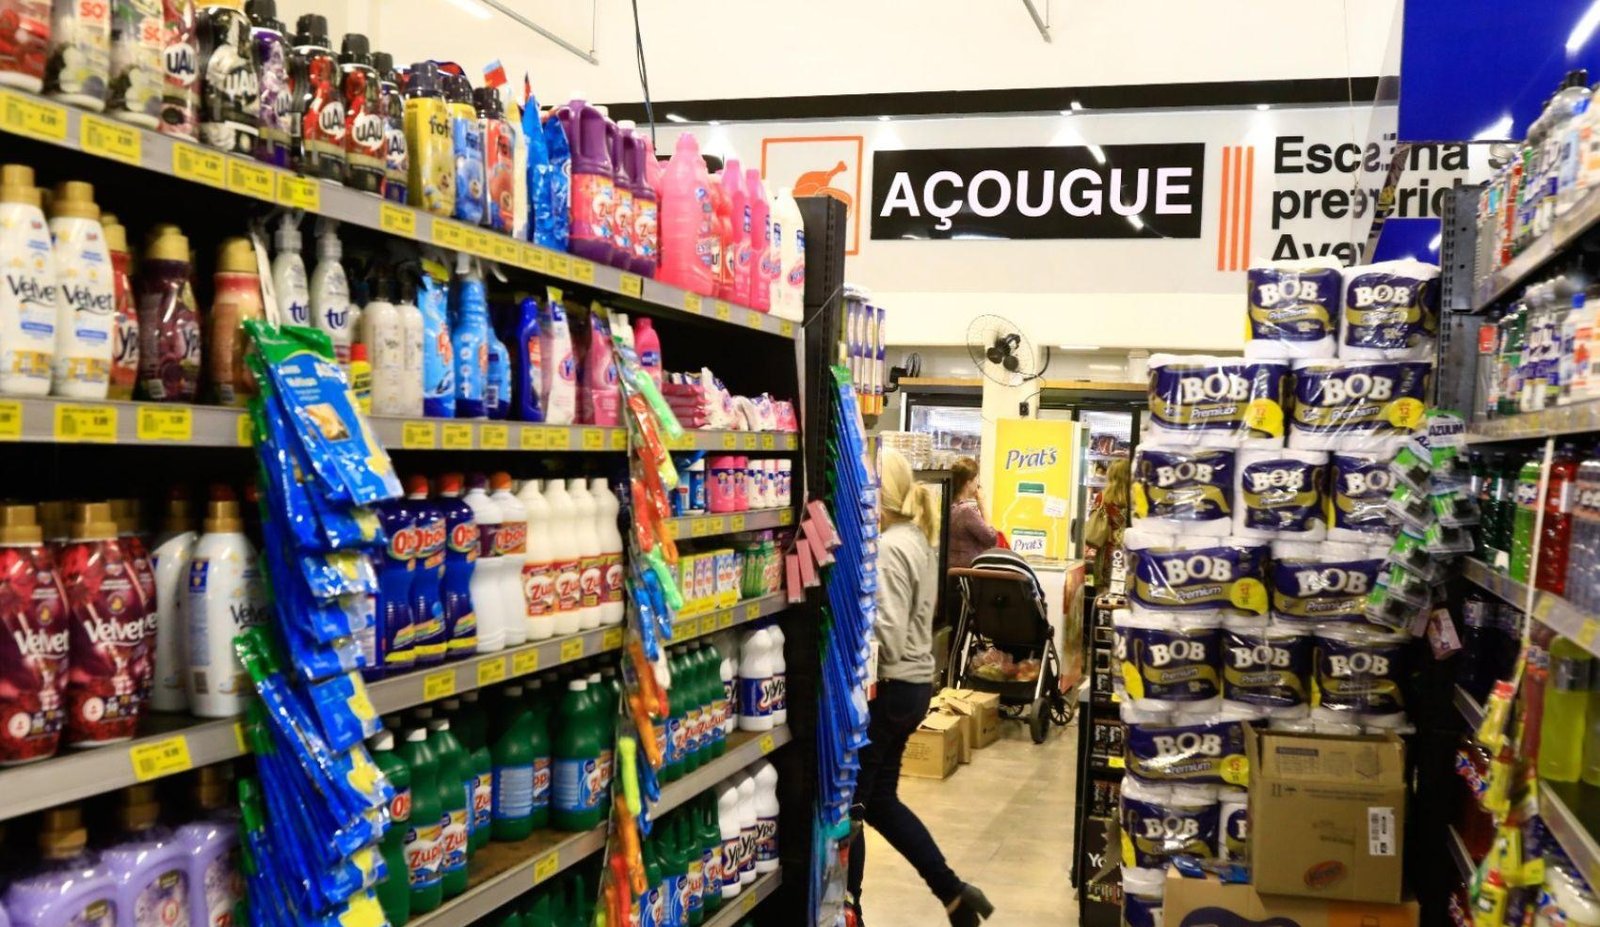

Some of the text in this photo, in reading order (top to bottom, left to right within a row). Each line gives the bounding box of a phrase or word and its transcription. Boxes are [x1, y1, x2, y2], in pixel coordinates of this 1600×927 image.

[879, 167, 1193, 231] AÇOUGUE
[1258, 278, 1319, 307] BOB
[1354, 284, 1411, 308] BOB
[1181, 373, 1250, 404] BOB
[1321, 373, 1393, 406] BOB
[1190, 404, 1238, 420] Premium
[1330, 405, 1381, 422] Premium
[1006, 448, 1057, 470] Prat's
[1156, 461, 1213, 487] BOB
[1252, 469, 1303, 492] BOB
[1013, 536, 1043, 551] Prat's
[1163, 555, 1232, 586] BOB
[1295, 568, 1368, 597] BOB
[1177, 585, 1222, 601] Premium
[14, 628, 70, 655] Velvet
[84, 616, 145, 644] Velvet
[1149, 640, 1206, 668] BOB
[1234, 645, 1290, 669] BOB
[1329, 652, 1389, 677] BOB
[1153, 732, 1221, 758] BOB
[1143, 816, 1199, 838] BOB
